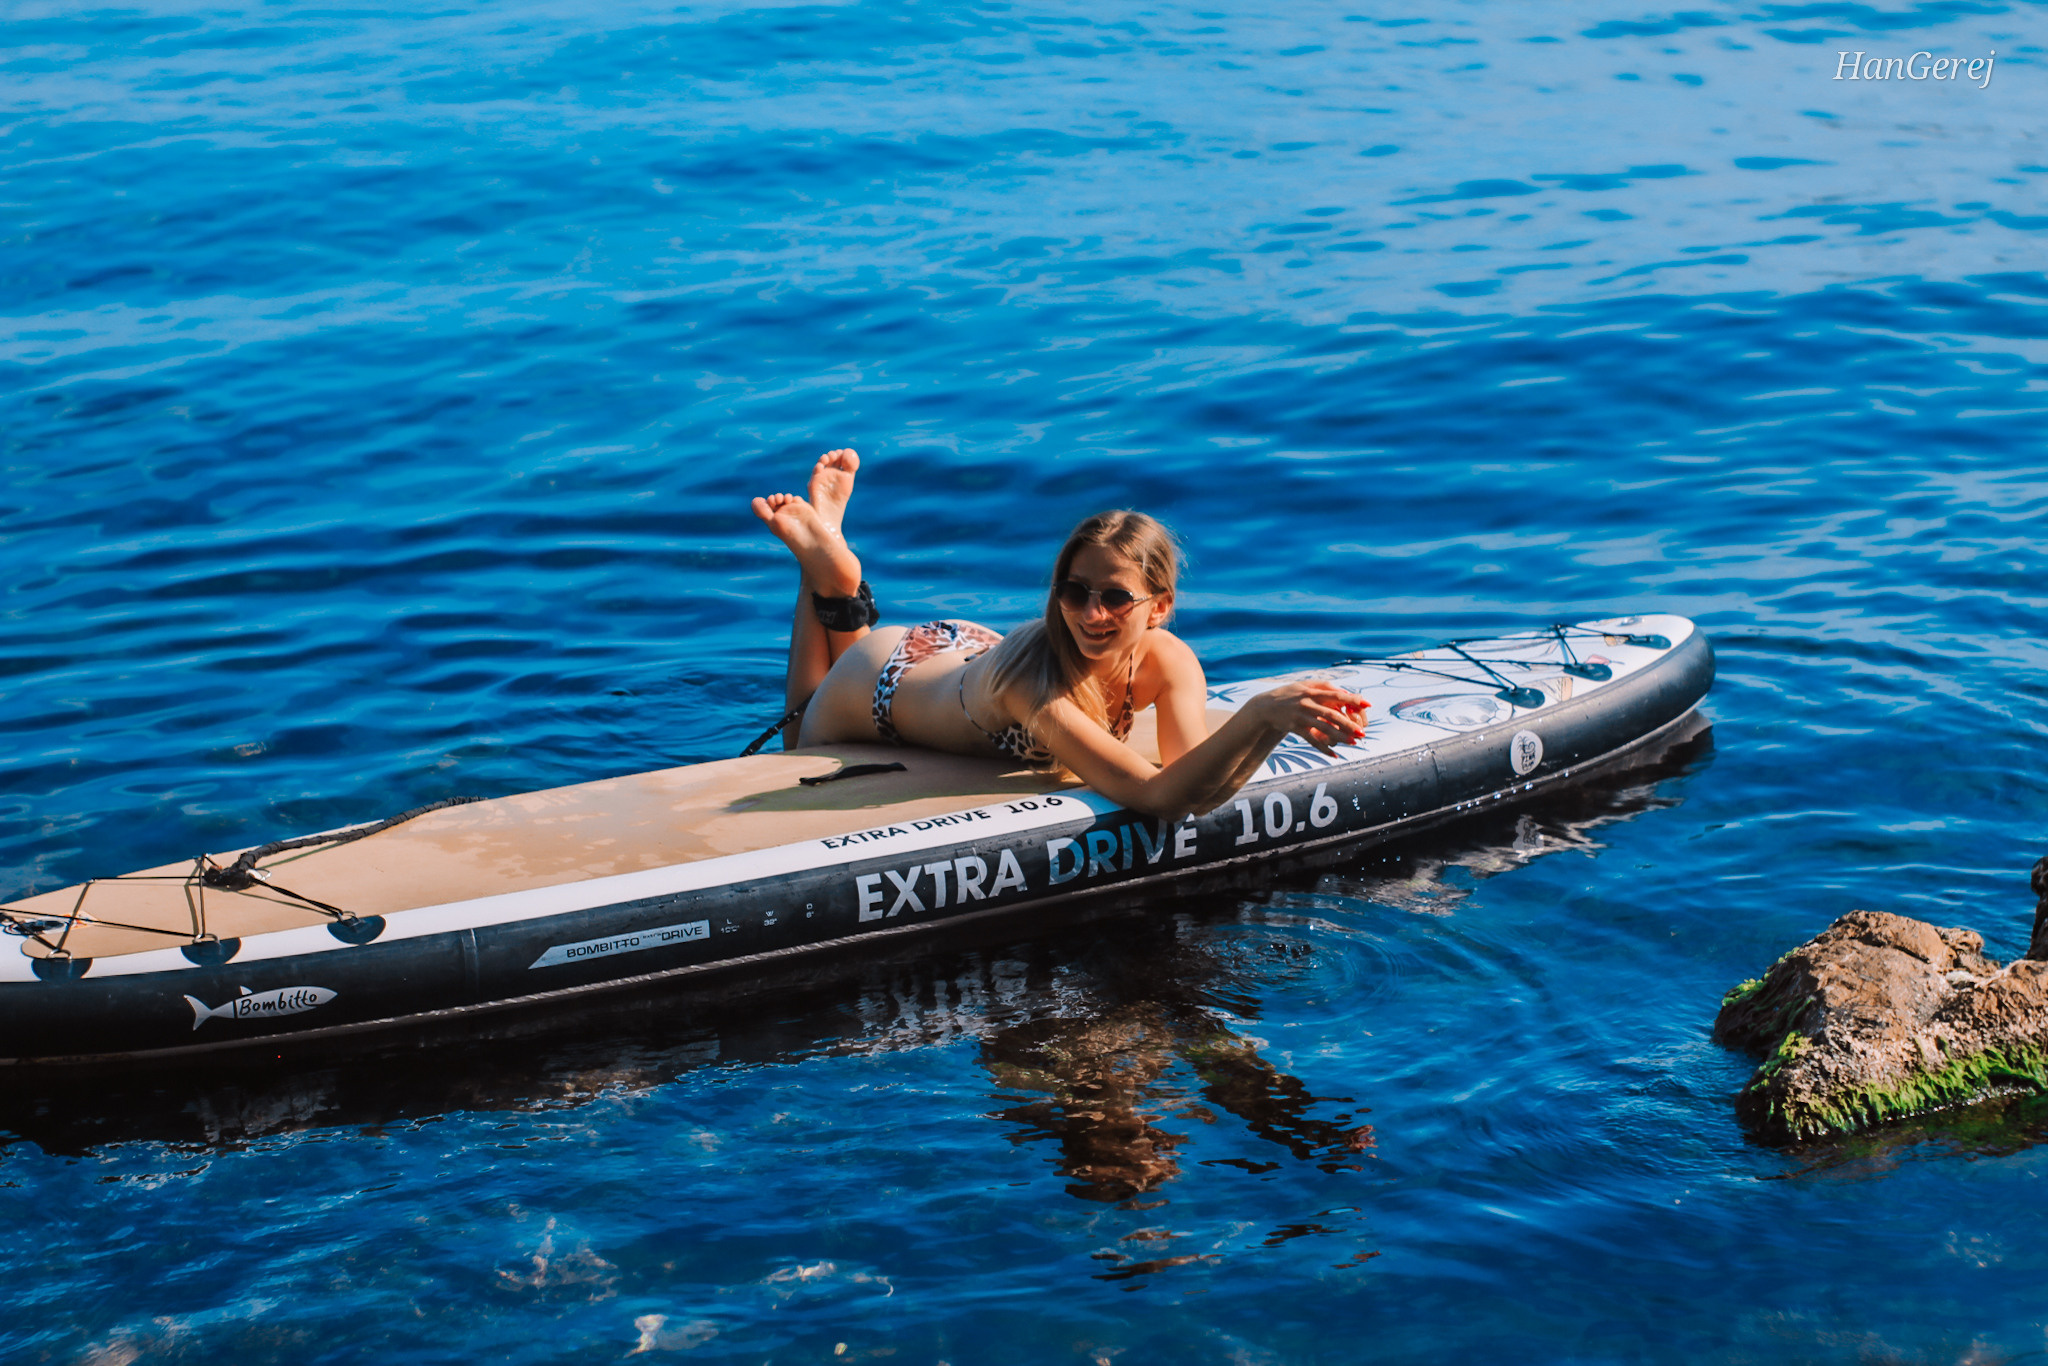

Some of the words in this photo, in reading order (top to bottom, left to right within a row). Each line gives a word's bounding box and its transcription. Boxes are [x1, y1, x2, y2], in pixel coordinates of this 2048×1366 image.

[820, 827, 908, 849] EXTRA
[911, 809, 992, 831] DRIVE
[1003, 797, 1064, 815] 10.6
[855, 848, 1028, 923] EXTRA
[1046, 812, 1198, 886] DRIVE
[1234, 782, 1339, 846] 10.6
[567, 937, 640, 958] BOMBITTO
[661, 926, 703, 941] DRIVE
[239, 990, 318, 1016] Bombitto
